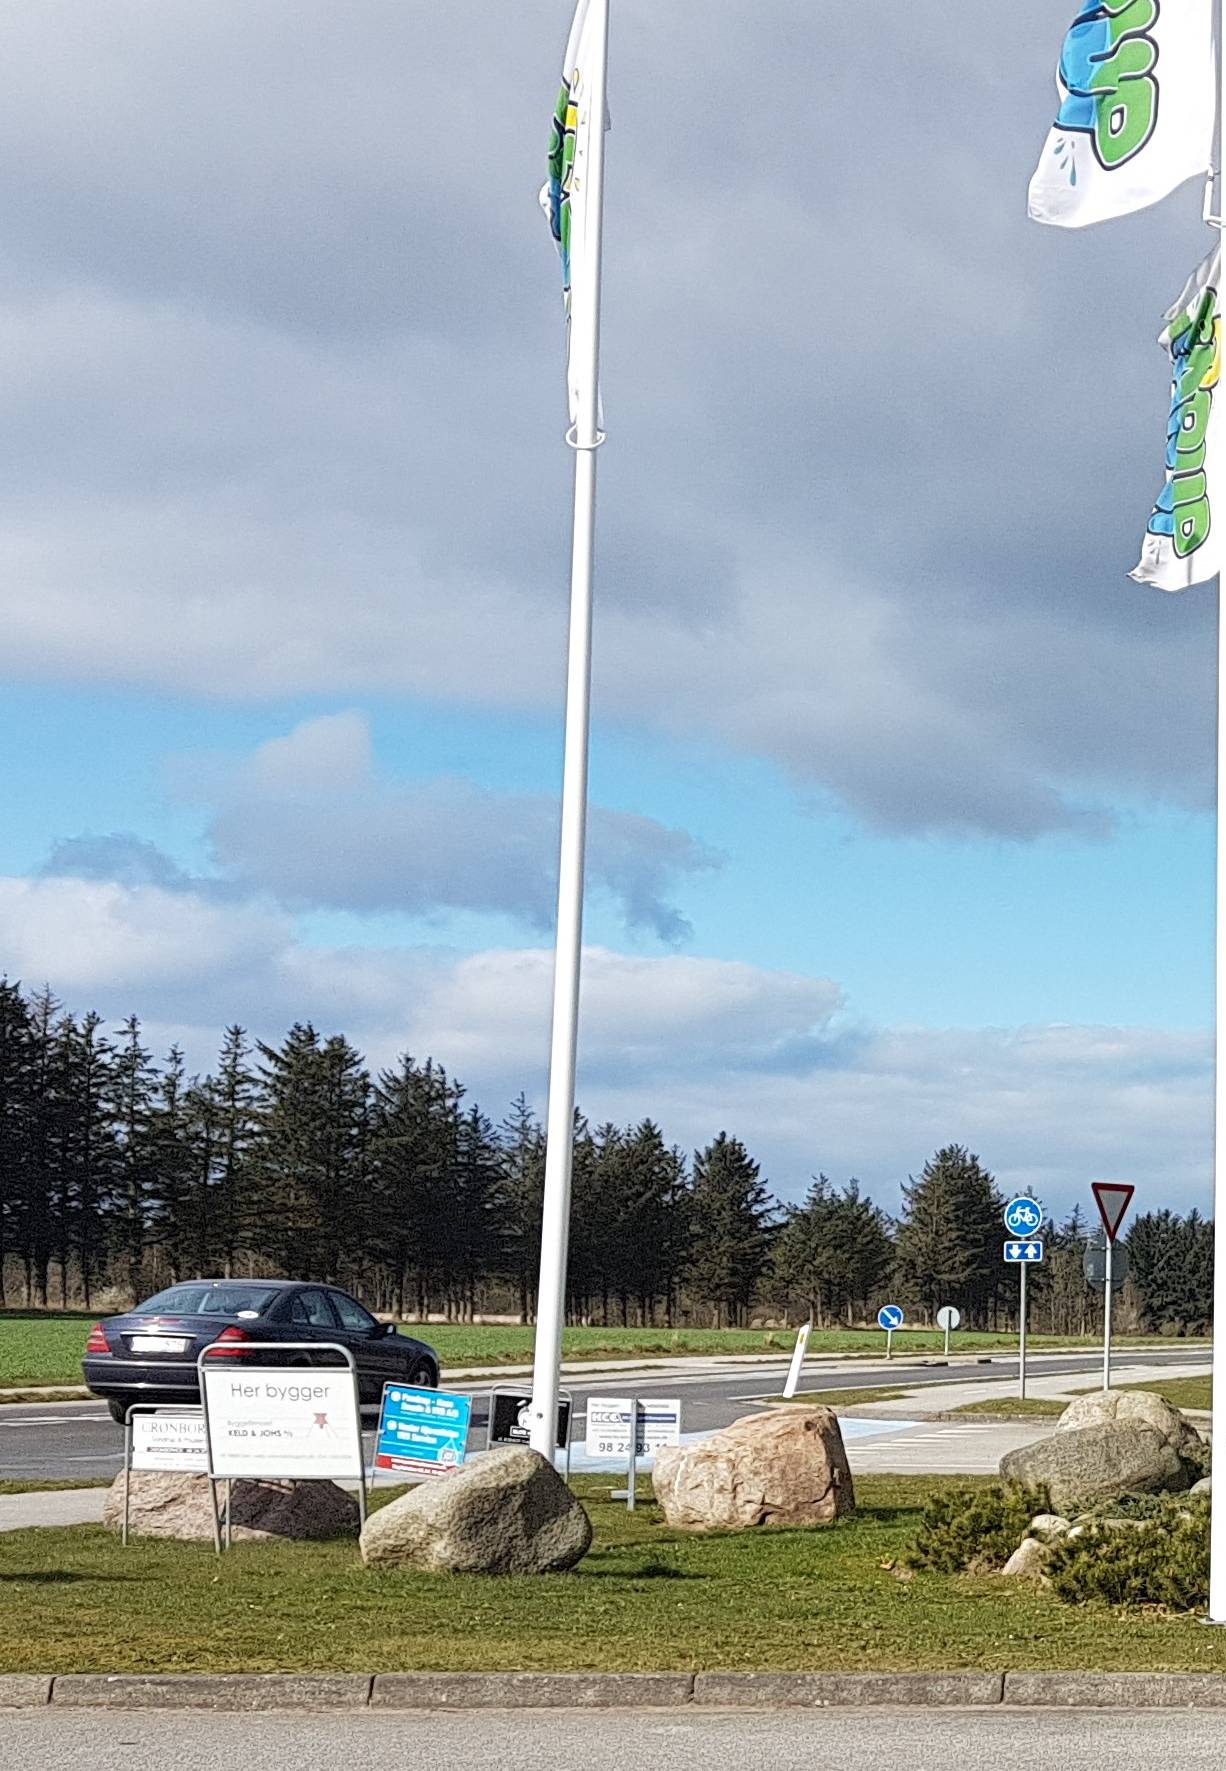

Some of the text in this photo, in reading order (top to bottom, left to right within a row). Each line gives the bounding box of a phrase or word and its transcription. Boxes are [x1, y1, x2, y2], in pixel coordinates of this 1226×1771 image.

[231, 1384, 331, 1402] Her bygger
[228, 1429, 249, 1437] KELD
[599, 1442, 613, 1453] 98
